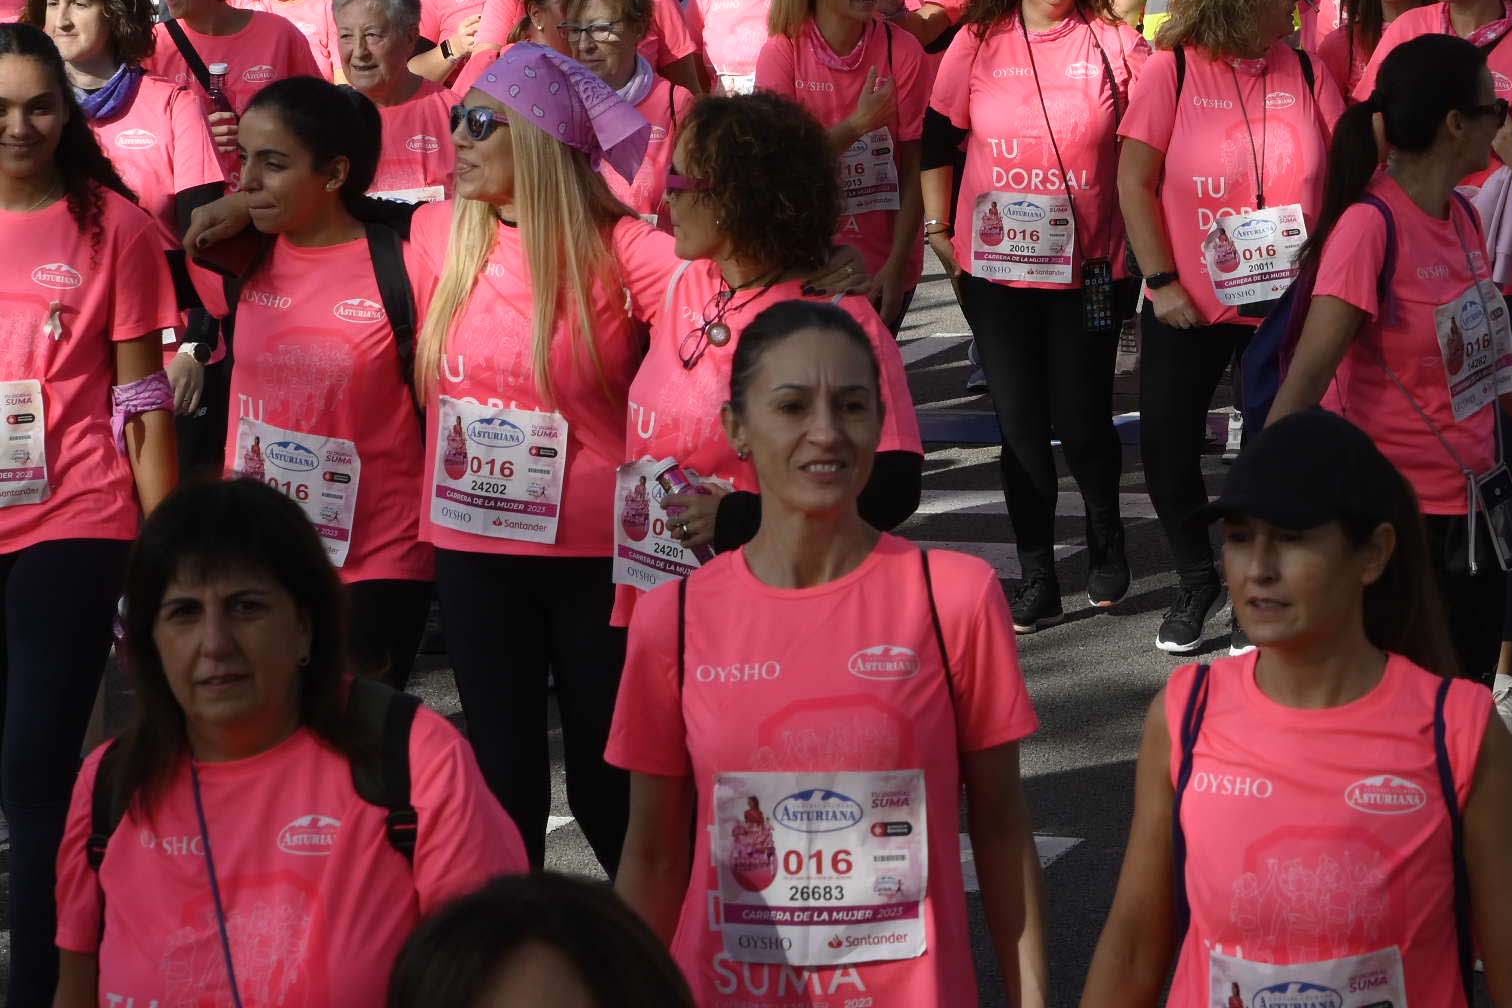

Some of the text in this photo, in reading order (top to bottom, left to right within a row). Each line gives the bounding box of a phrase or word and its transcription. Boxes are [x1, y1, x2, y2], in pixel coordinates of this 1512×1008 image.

[993, 67, 1034, 78] OYSHO
[1193, 96, 1233, 109] OYSHO
[987, 138, 1019, 159] TU
[992, 167, 1090, 191] DORSAL
[1192, 176, 1225, 198] TU
[1005, 208, 1043, 219] ASTURIANA
[1006, 228, 1041, 242] 016
[1236, 224, 1276, 238] ASTURIANA
[1010, 244, 1036, 254] 20015
[1242, 244, 1277, 262] 016
[981, 264, 1011, 274] OYSHO
[1034, 268, 1065, 276] Santander
[1249, 262, 1274, 273] 20011
[35, 271, 79, 285] ASTURIANA
[1224, 270, 1290, 287] CARRERA DE LA MUJER
[1224, 289, 1255, 300] OYSHO
[336, 307, 382, 320] ASTURIANA
[1466, 333, 1490, 357] 016
[6, 398, 33, 406] SUMA
[628, 400, 656, 440] TU
[470, 428, 520, 444] ASTURIANA
[531, 429, 558, 439] SUMA
[268, 448, 314, 467] ASTURIANA
[325, 455, 352, 465] SUMA
[470, 456, 515, 479] 016
[471, 480, 507, 495] 24202
[446, 490, 546, 513] CARRERA DE LA MUJER 2023
[441, 506, 472, 524] OYSHO
[504, 519, 548, 533] Santander
[654, 542, 684, 560] 24201
[628, 551, 674, 571] CARRERA DE LA
[627, 566, 656, 585] OYSHO
[696, 661, 781, 683] OYSHO
[854, 655, 918, 673] ASTURIANA
[1193, 772, 1272, 799] OYSHO
[871, 798, 910, 809] SUMA
[1351, 787, 1420, 806] ASTURIANA
[781, 805, 856, 822] ASTURIANA
[783, 849, 854, 876] 016
[789, 885, 845, 901] 26683
[742, 907, 903, 922] CARRERA DE LA MUJER 2023
[738, 934, 792, 951] OYSHO
[846, 933, 908, 948] Santander
[713, 951, 867, 997] SUMA
[1351, 976, 1388, 992] SUMA
